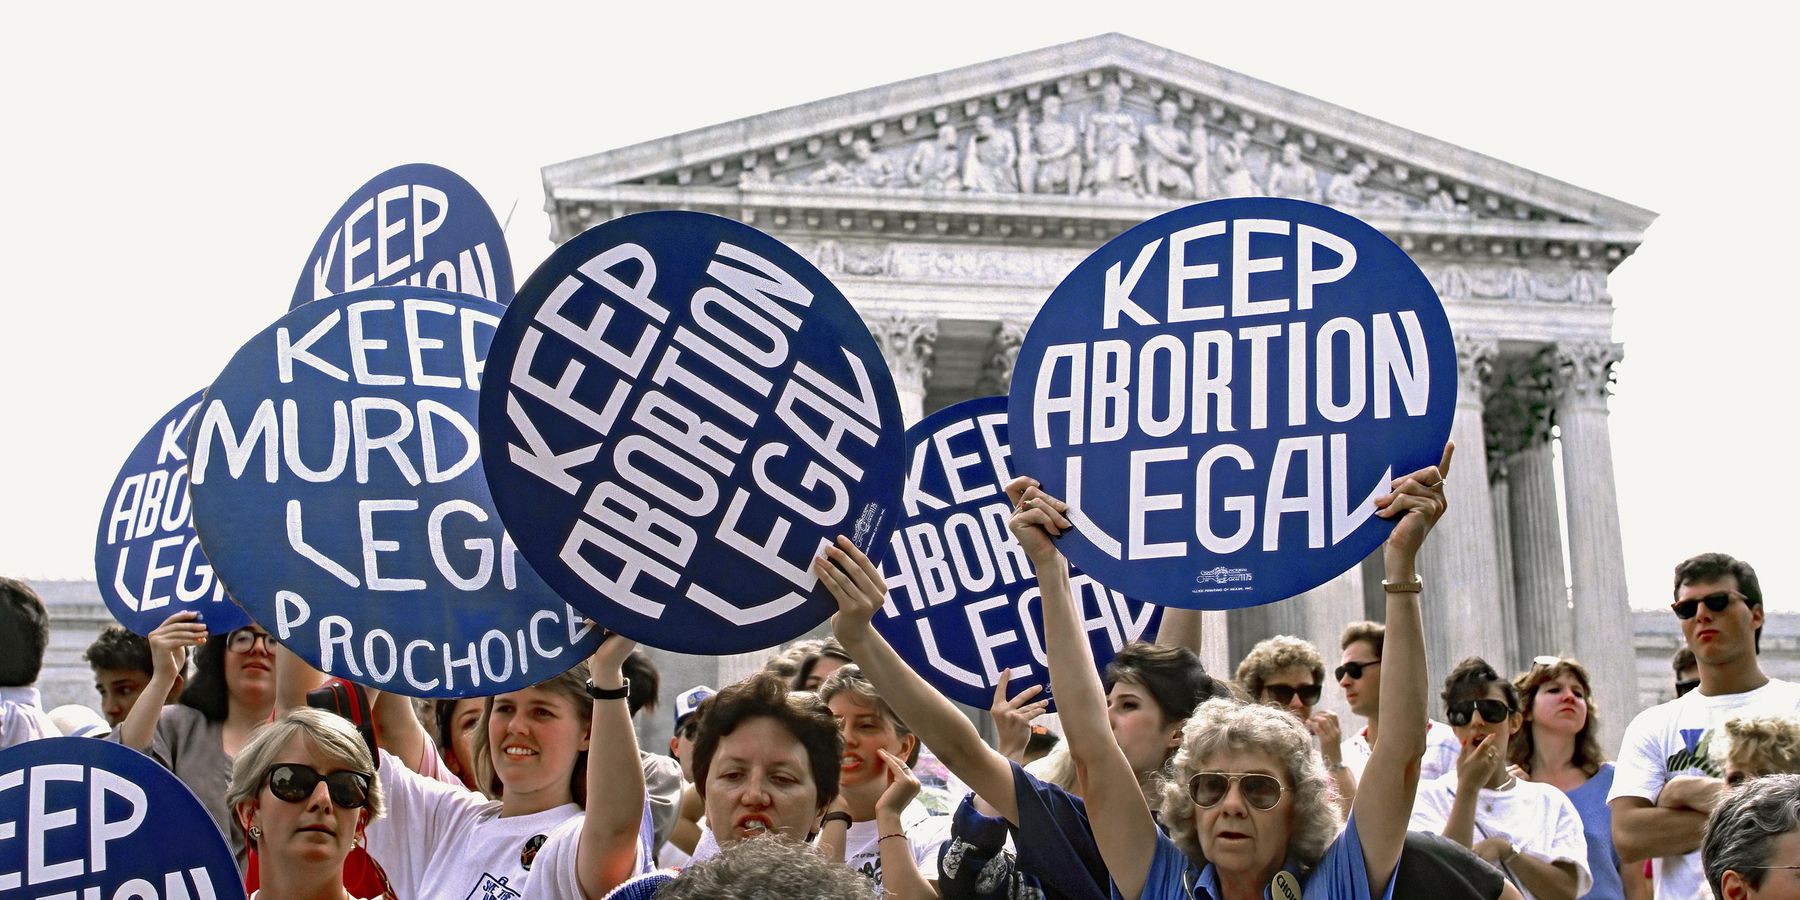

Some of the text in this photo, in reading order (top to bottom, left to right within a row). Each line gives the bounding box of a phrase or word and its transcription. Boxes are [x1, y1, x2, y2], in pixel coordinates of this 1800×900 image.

[314, 184, 449, 301] KEEP
[1103, 218, 1357, 330] KEEP
[507, 243, 671, 496] KEEP
[1034, 310, 1430, 450] ABORTION
[190, 397, 481, 486] MURD
[559, 242, 814, 619] ABORTION
[686, 346, 881, 626] LEGAL
[903, 413, 1012, 518] KEE
[107, 464, 194, 545] ABO
[286, 499, 517, 592] LEG
[1066, 433, 1392, 561] LEGAL
[114, 535, 225, 613] LEG
[877, 503, 1037, 619] ABOR
[1277, 874, 1297, 900] CHOI
